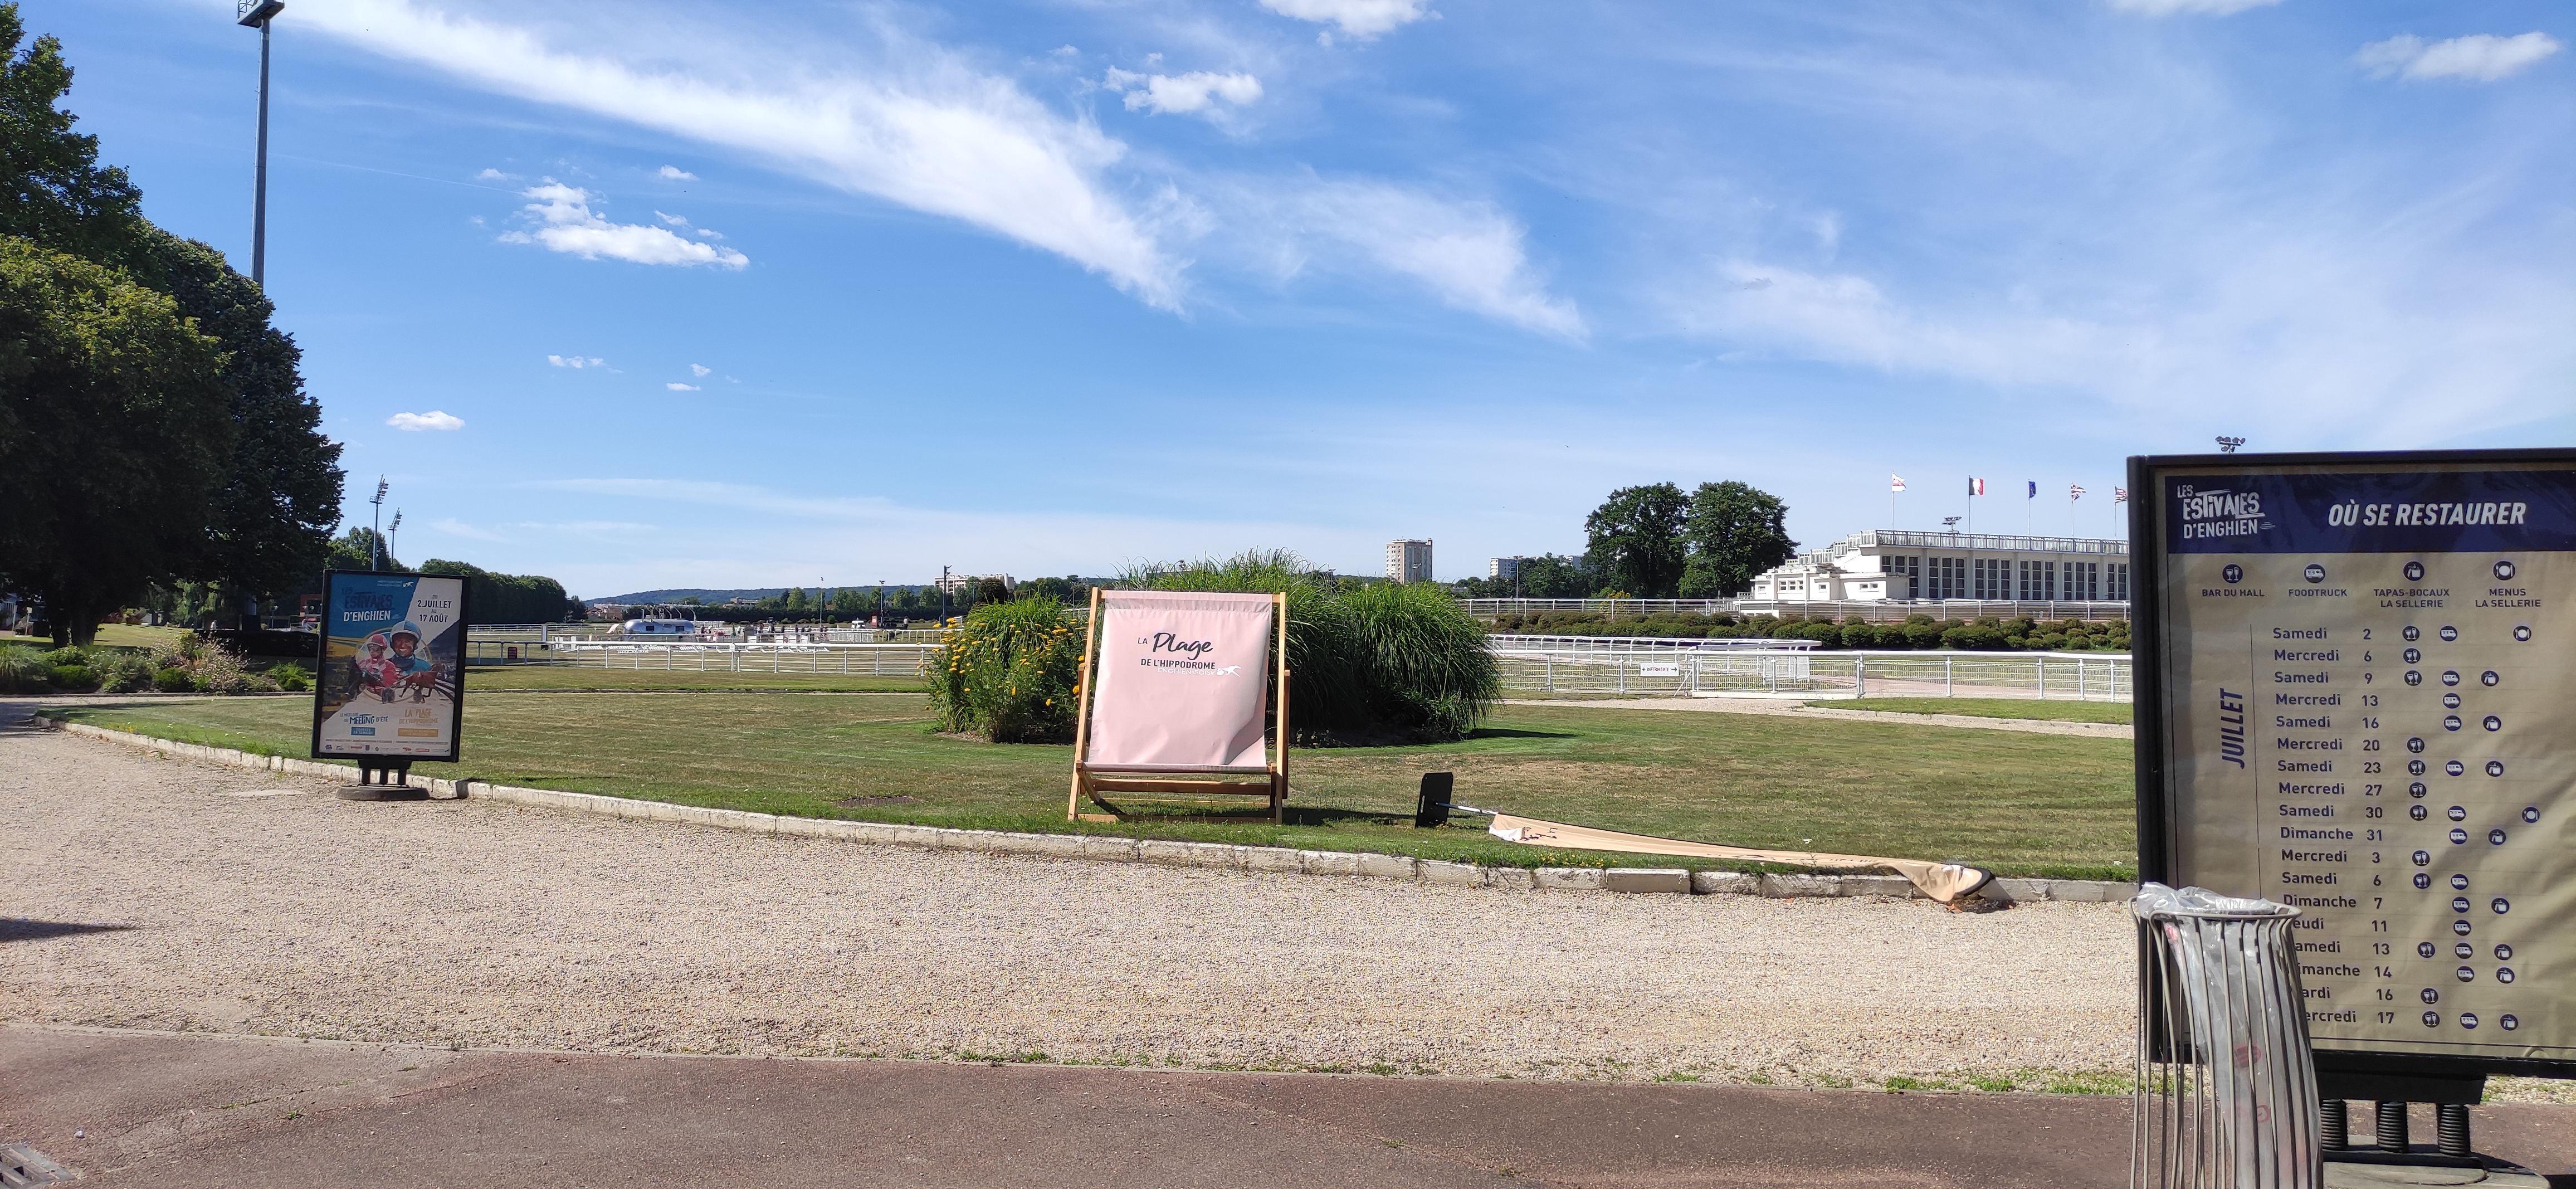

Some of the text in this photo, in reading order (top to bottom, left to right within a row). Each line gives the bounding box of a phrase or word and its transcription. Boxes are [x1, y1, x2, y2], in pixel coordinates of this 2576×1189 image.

[2177, 485, 2193, 498] LES
[2328, 499, 2526, 526] OÙ SE RESTAURER
[2183, 519, 2258, 539] D'ENGHIEN
[2289, 588, 2347, 597] FOODTRUCK
[2373, 588, 2450, 597] TAPAS-BOCAUX
[422, 600, 452, 608] JUILLET
[2380, 600, 2443, 608] LA SELLERIE
[2491, 599, 2541, 607] SELLERIE
[343, 610, 391, 622] D'ENGHIEN
[429, 614, 448, 622] AOÛT
[2273, 627, 2372, 640] Samedi 2
[1153, 632, 1213, 661] Plage
[2274, 649, 2372, 662] Mercredi 6
[1153, 659, 1216, 670] L'HIPPODROME
[2274, 671, 2373, 684] Samedi 9
[2276, 693, 2379, 706] Mercredi 13
[405, 708, 432, 718] LA PLAGE
[2220, 688, 2245, 769] JUILLET
[2276, 715, 2379, 729] Samedi 16
[2277, 738, 2380, 751] Mercredi 20
[2277, 759, 2382, 774] Samedi 23
[2279, 782, 2383, 796] Mercredi 27
[2279, 804, 2383, 818] Samedi 30
[2280, 826, 2383, 841] Dimanche 31
[2281, 849, 2380, 864] Mercredi 3
[2282, 871, 2382, 886] Samedi 6
[2284, 894, 2383, 909] Dimanche 7
[2293, 918, 2387, 932] eudi 11
[2295, 941, 2390, 955] amedi 13
[2297, 962, 2393, 978] imanche 14
[2302, 986, 2394, 1001] ardi 16
[2306, 1010, 2395, 1024] ercredi 17
